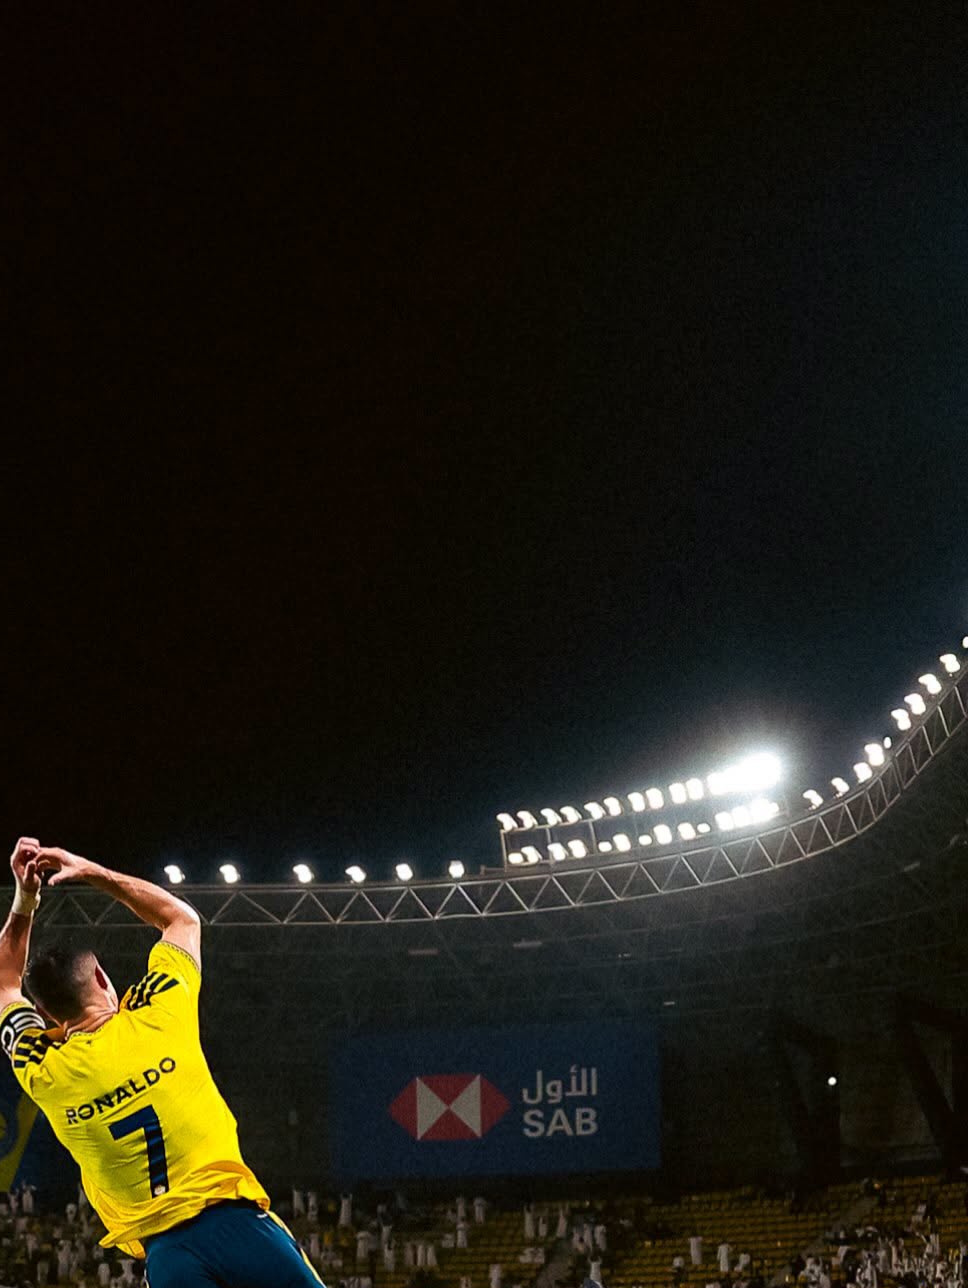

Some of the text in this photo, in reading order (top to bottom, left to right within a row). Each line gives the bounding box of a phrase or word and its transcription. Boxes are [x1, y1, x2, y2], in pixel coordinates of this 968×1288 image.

[66, 1057, 176, 1125] RONALDO
[521, 1064, 599, 1105] الأول
[522, 1107, 599, 1138] SAB
[108, 1104, 169, 1199] 7
